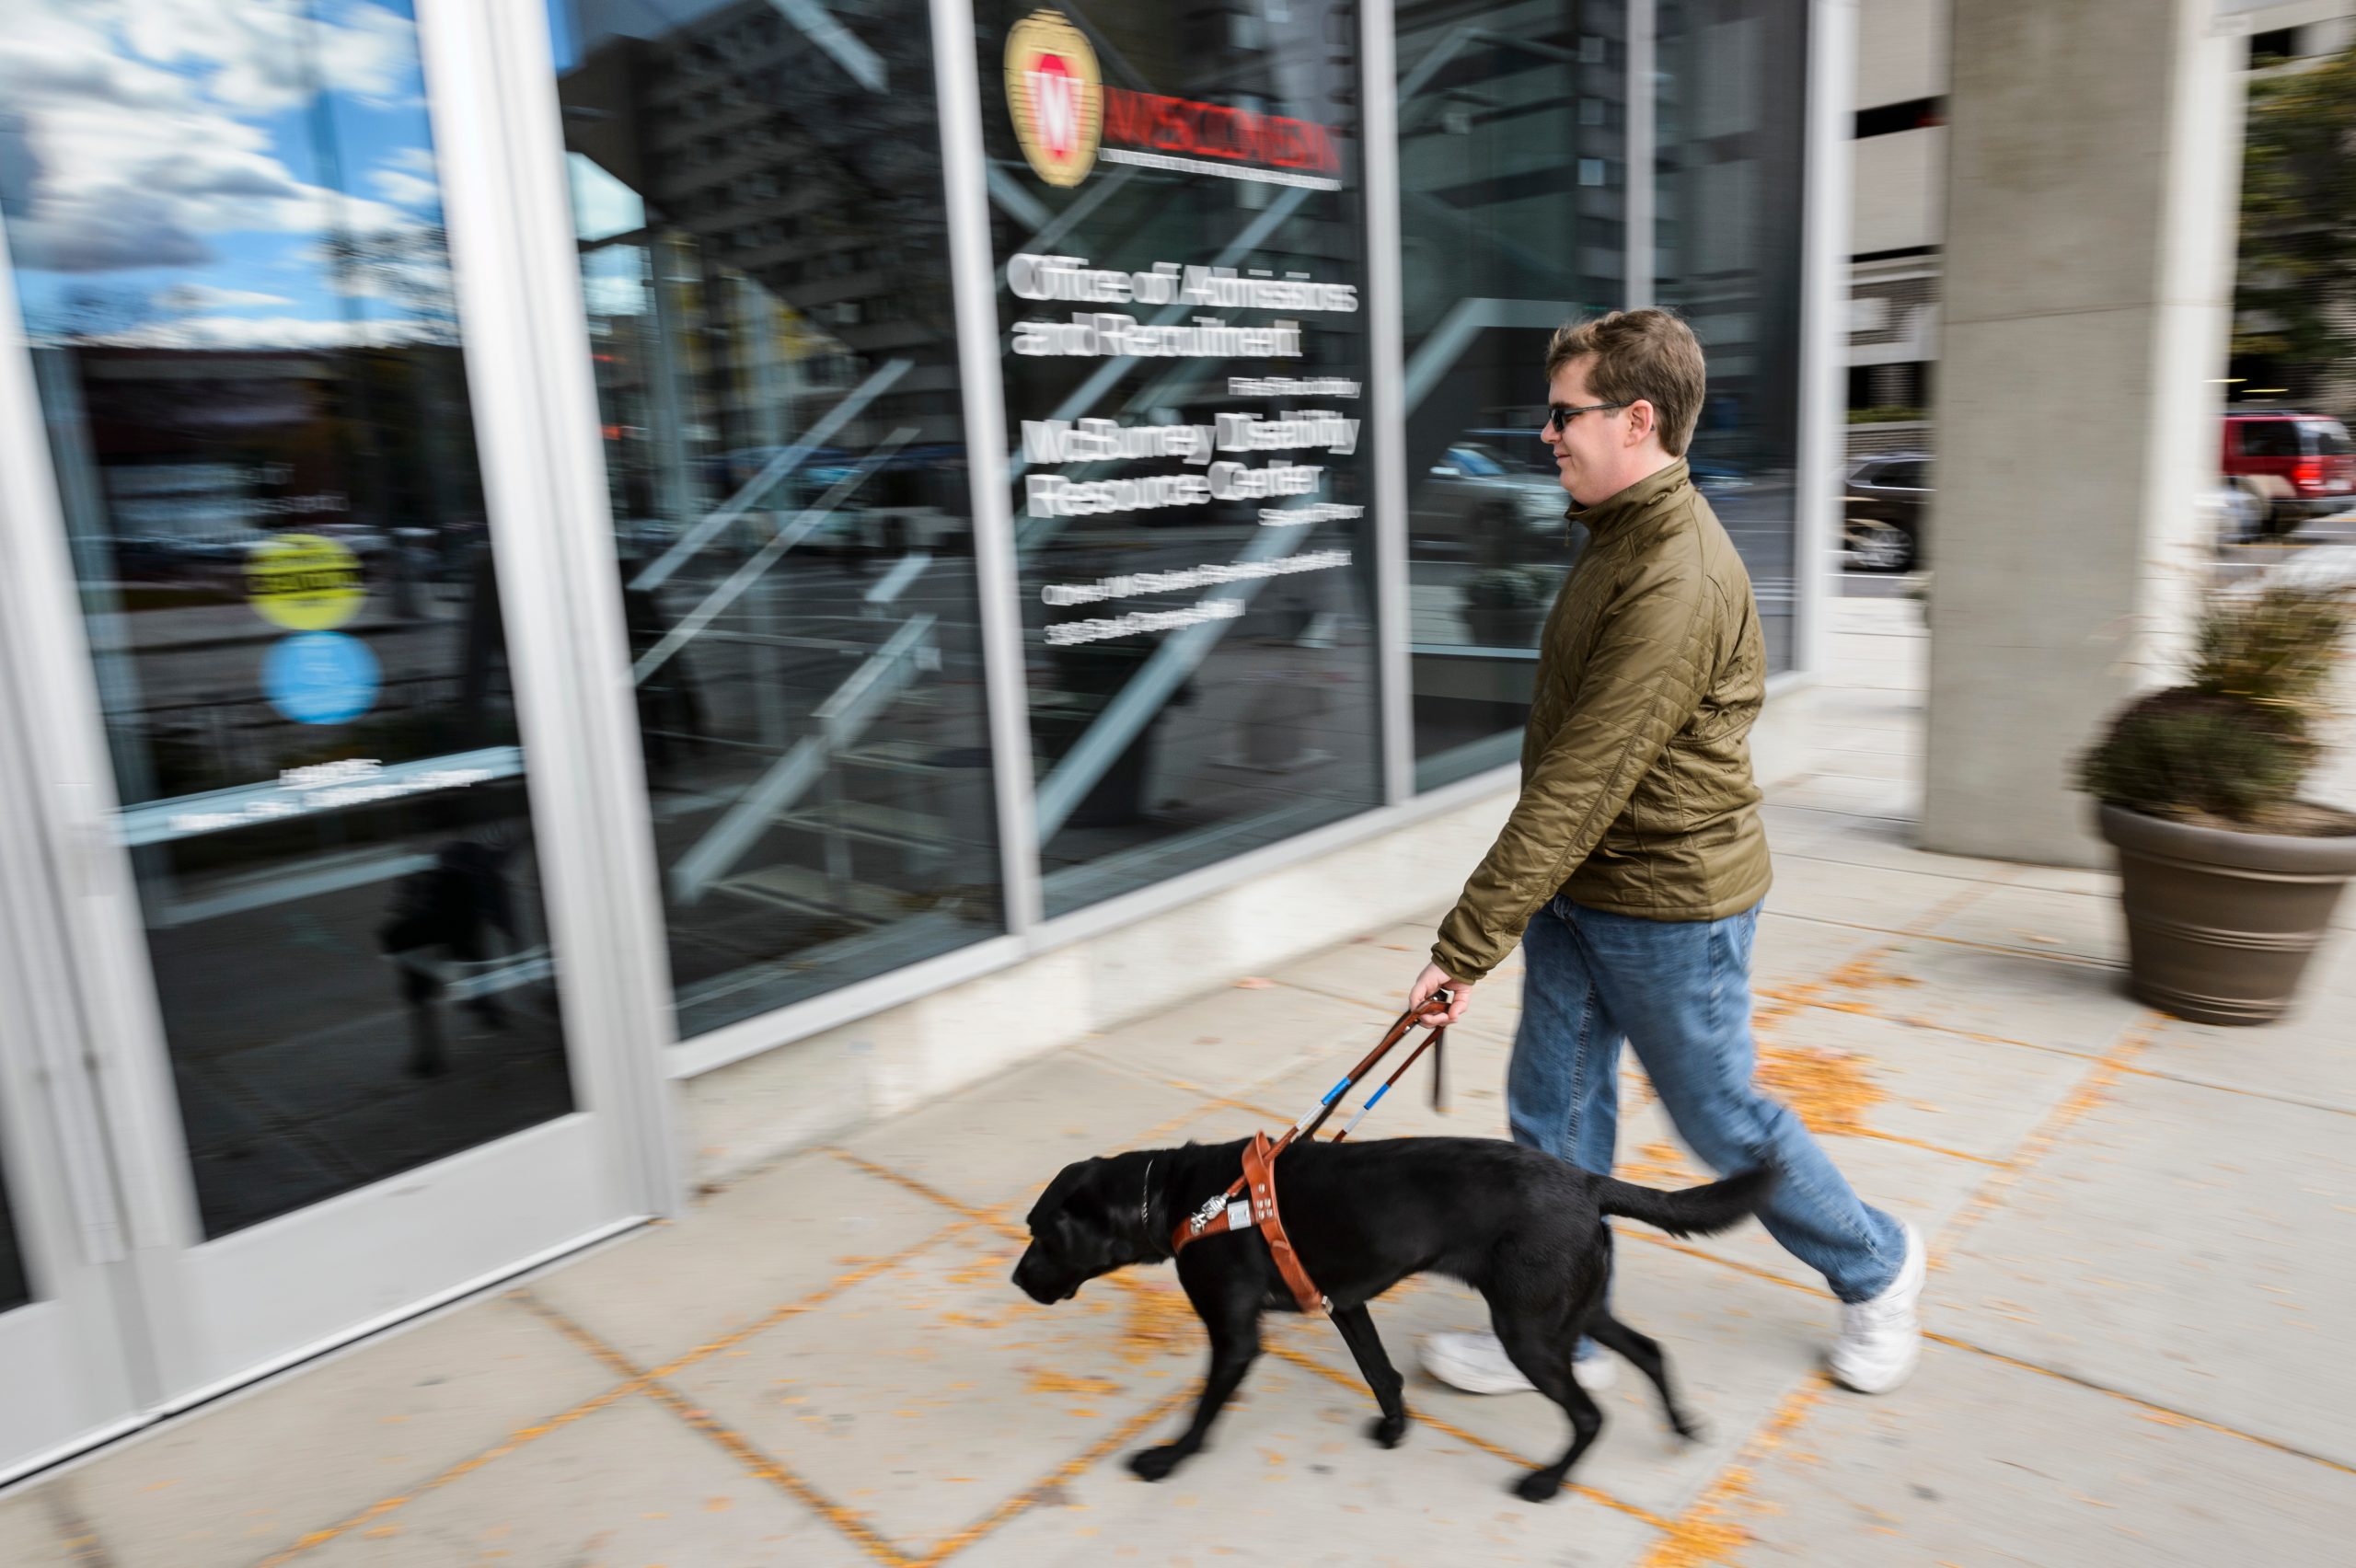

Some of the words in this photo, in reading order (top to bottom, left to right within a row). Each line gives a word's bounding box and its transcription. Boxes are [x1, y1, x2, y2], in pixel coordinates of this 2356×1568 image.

[1007, 253, 1132, 304] Office
[1132, 261, 1181, 305] of
[1179, 264, 1358, 313] Admissions
[1011, 312, 1097, 356] and
[1092, 313, 1303, 357] Recruitment
[1025, 474, 1211, 518] Resource
[1207, 461, 1324, 501] Center
